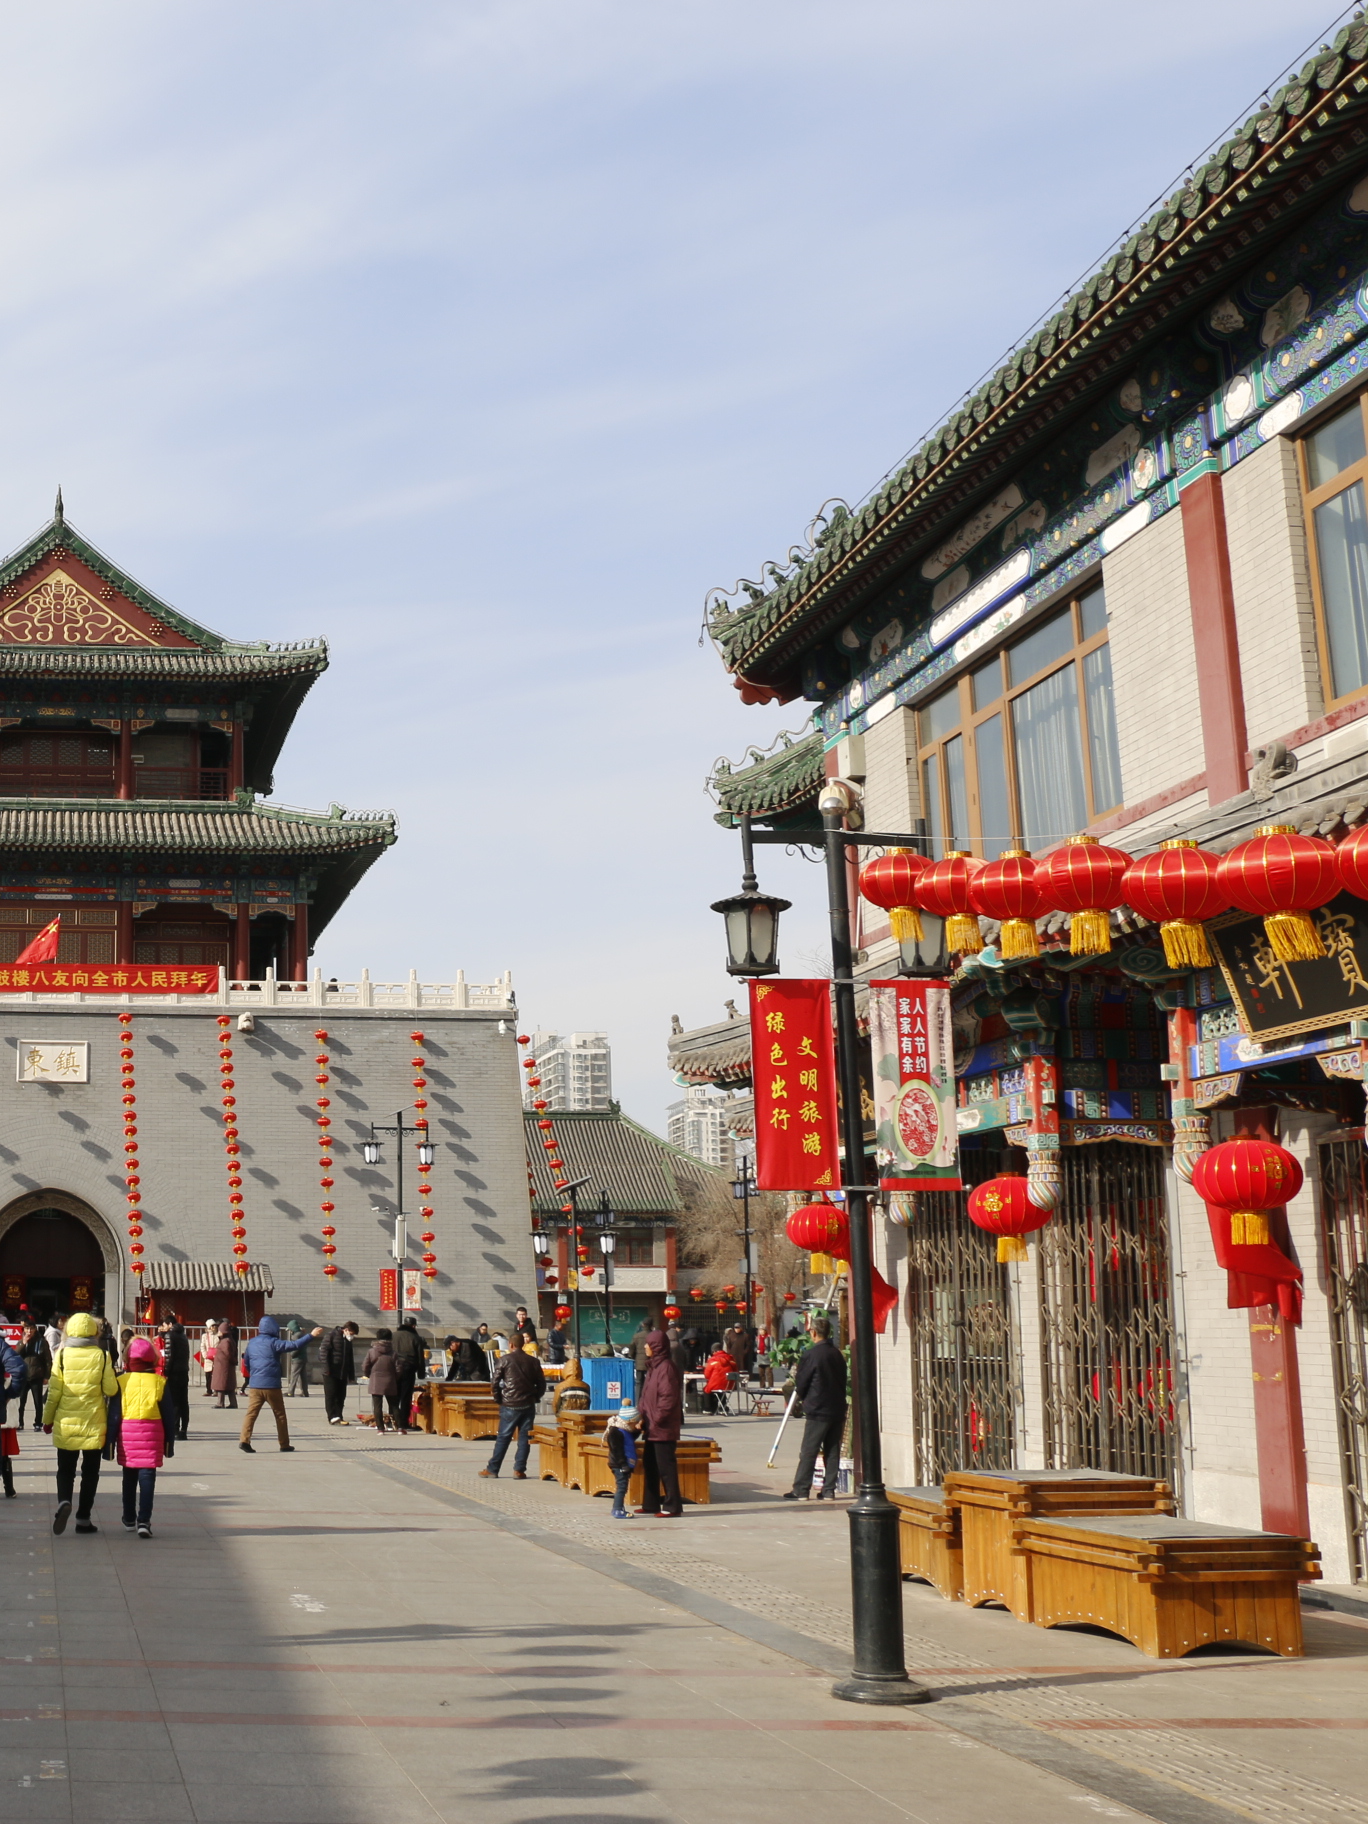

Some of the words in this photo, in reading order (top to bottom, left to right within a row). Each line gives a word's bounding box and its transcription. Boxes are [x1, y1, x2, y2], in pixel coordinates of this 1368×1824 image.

[765, 1011, 792, 1131] 绿色出行
[898, 997, 915, 1075] 家家有余
[912, 997, 928, 1075] 人人节约
[796, 1035, 823, 1156] 文明旅游
